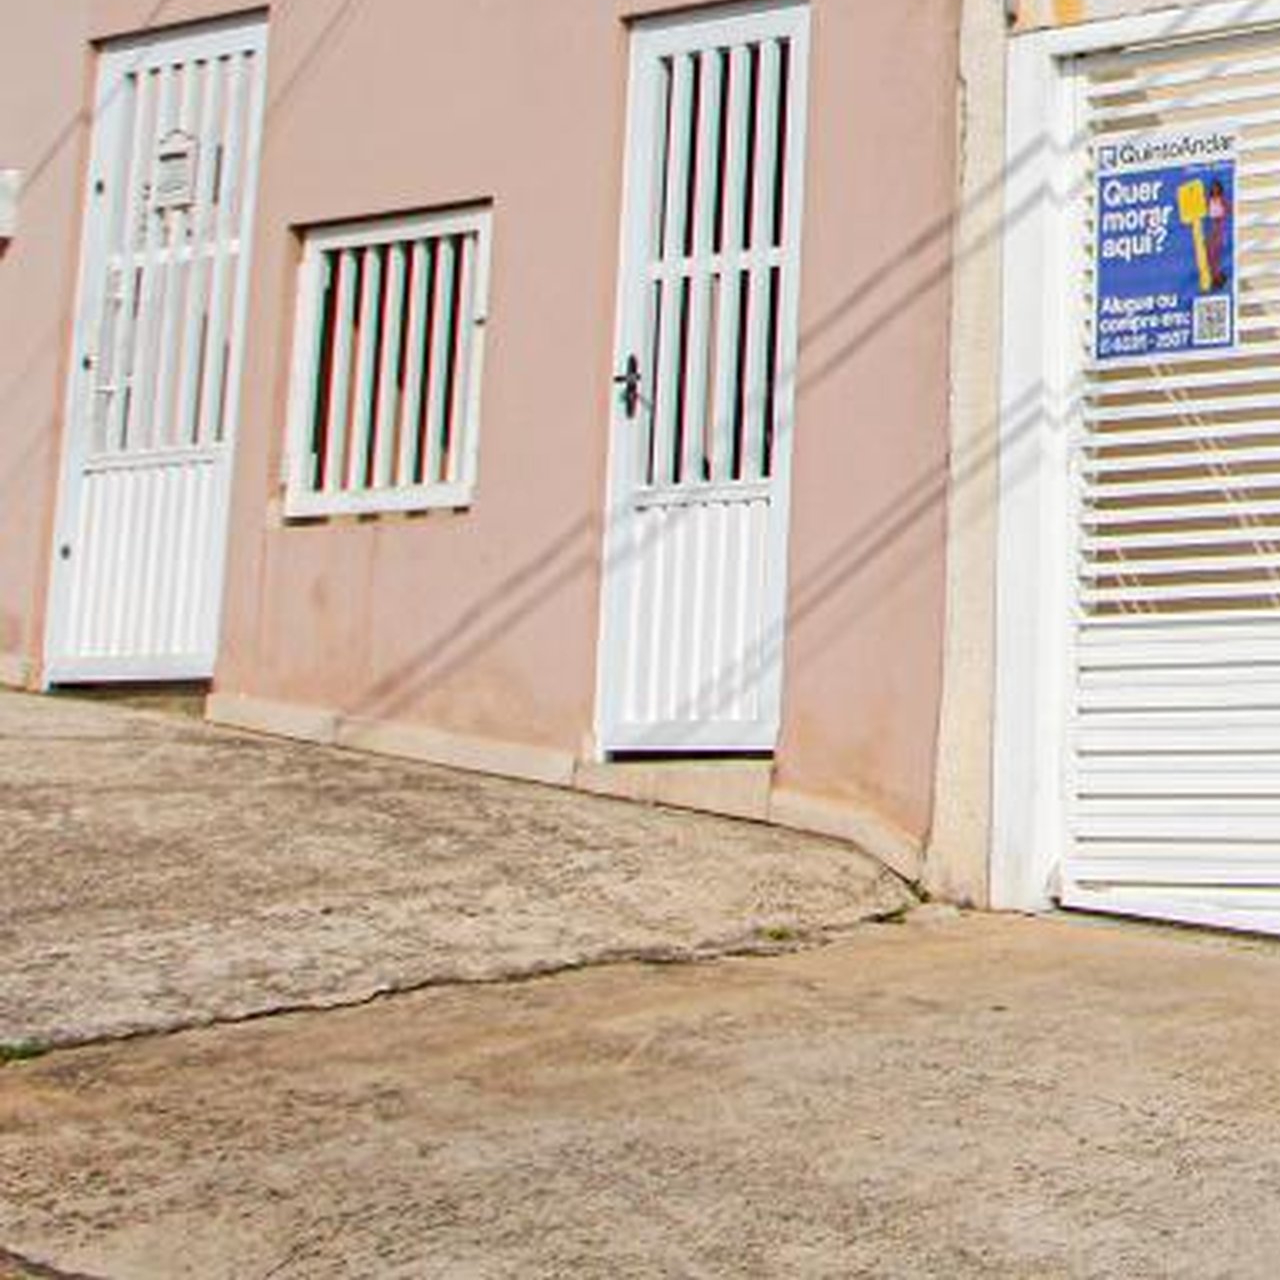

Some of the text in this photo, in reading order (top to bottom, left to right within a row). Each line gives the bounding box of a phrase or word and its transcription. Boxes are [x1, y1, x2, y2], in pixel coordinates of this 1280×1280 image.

[1119, 133, 1235, 165] QuintoAndar
[1102, 180, 1163, 208] Quer
[1102, 205, 1174, 234] morar
[1102, 224, 1168, 262] aqui?
[1156, 293, 1178, 309] ou
